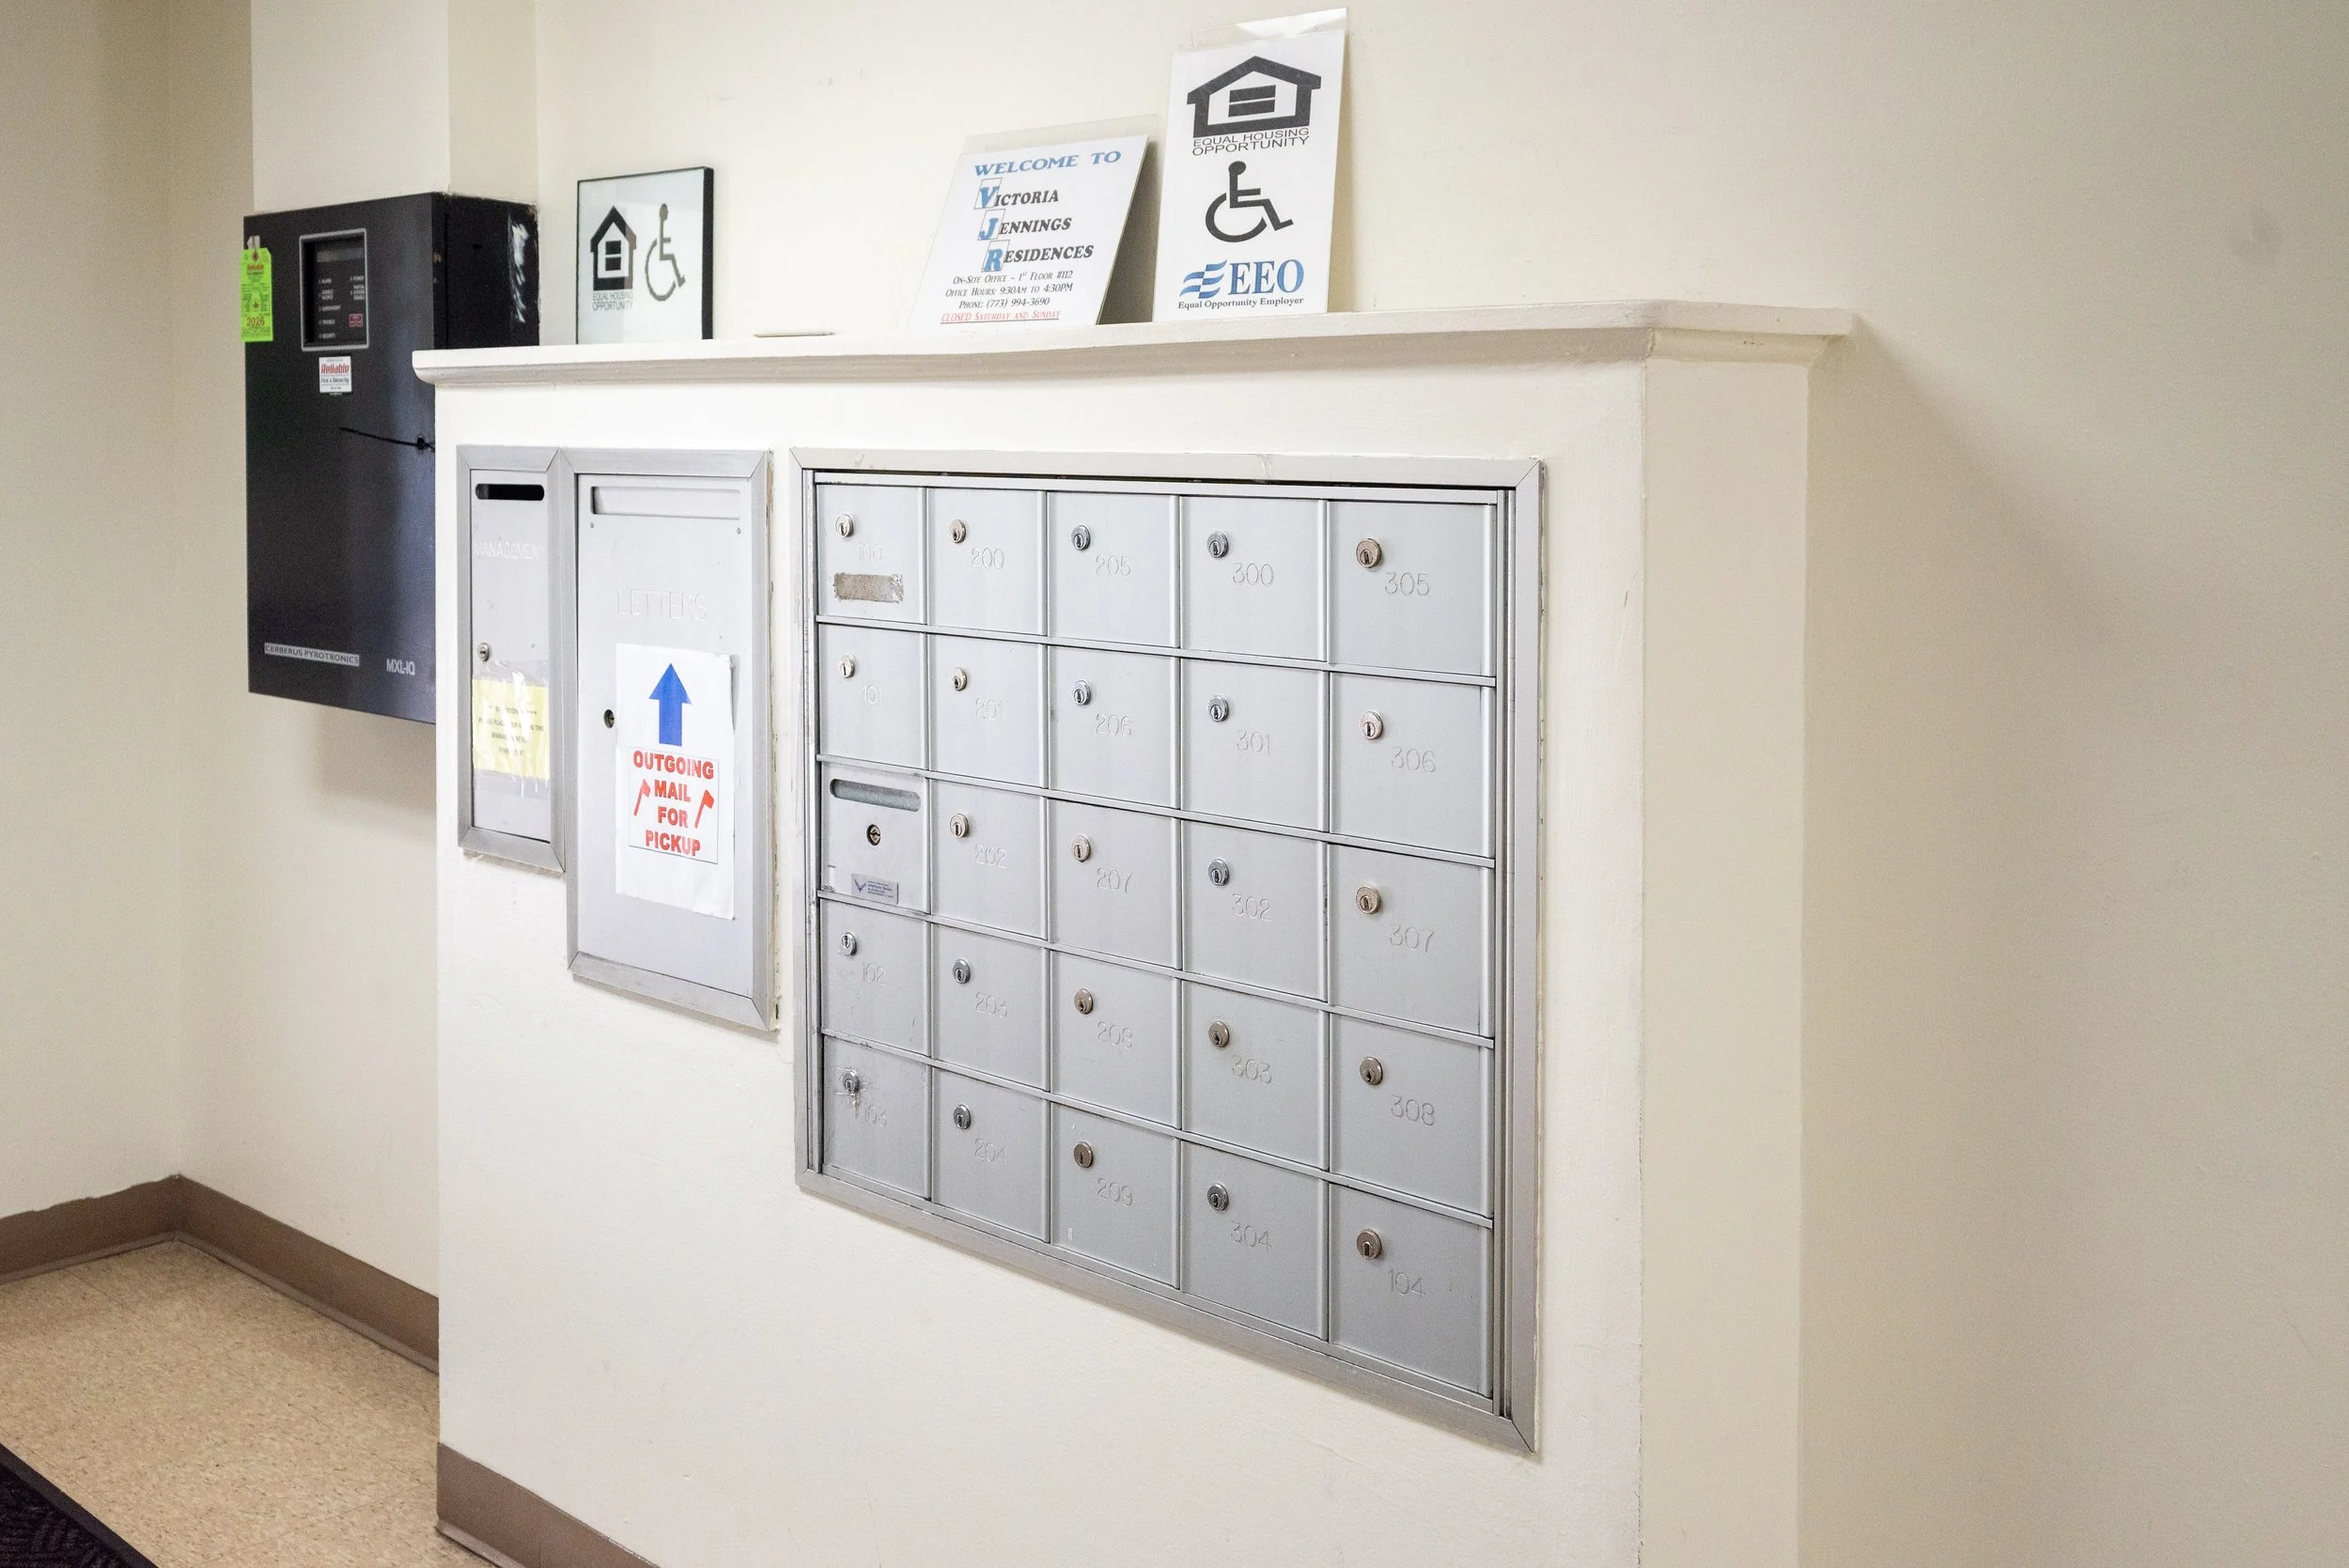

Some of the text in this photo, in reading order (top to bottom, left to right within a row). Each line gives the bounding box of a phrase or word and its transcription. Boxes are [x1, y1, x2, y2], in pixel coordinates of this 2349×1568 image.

[1191, 135, 1311, 157] OPPORTUNITY
[1192, 127, 1310, 147] EQUAL HOUSING
[973, 149, 1123, 177] WELCOME TO
[1043, 283, 1074, 292] 4:30PM
[1056, 270, 1074, 279] #112
[1227, 258, 1305, 296] EEO
[592, 290, 633, 302] EQUAL HOUSING
[592, 300, 633, 311] OPPORTUNITY
[987, 298, 1009, 308] (773)
[1011, 297, 1050, 307] 994-3690
[1177, 297, 1304, 310] Equal Opportunity Employer
[971, 546, 1005, 570] 200
[1096, 554, 1132, 578] 205
[1232, 562, 1275, 587] 300
[1384, 571, 1432, 598] 305
[617, 588, 708, 622] LETTERS
[265, 644, 359, 665] CERBERUS PYROTRONICS
[386, 658, 416, 676] MXL-IQ
[1096, 712, 1133, 737] 206
[1237, 729, 1271, 755] 301
[632, 750, 714, 780] OUTGOING
[1391, 745, 1437, 774] 306
[654, 779, 692, 803] MAIL
[657, 805, 689, 829] FOR
[645, 829, 701, 857] PICKUP
[974, 843, 1008, 869] 202
[1097, 867, 1134, 893] 207
[1232, 893, 1272, 922] 302
[1389, 924, 1436, 955] 307
[1232, 1056, 1273, 1085] 303
[1390, 1094, 1436, 1126] 308
[974, 1138, 1007, 1165] 204
[1097, 1176, 1133, 1207] 209
[1230, 1221, 1272, 1253] 304
[1388, 1267, 1427, 1297] 104
